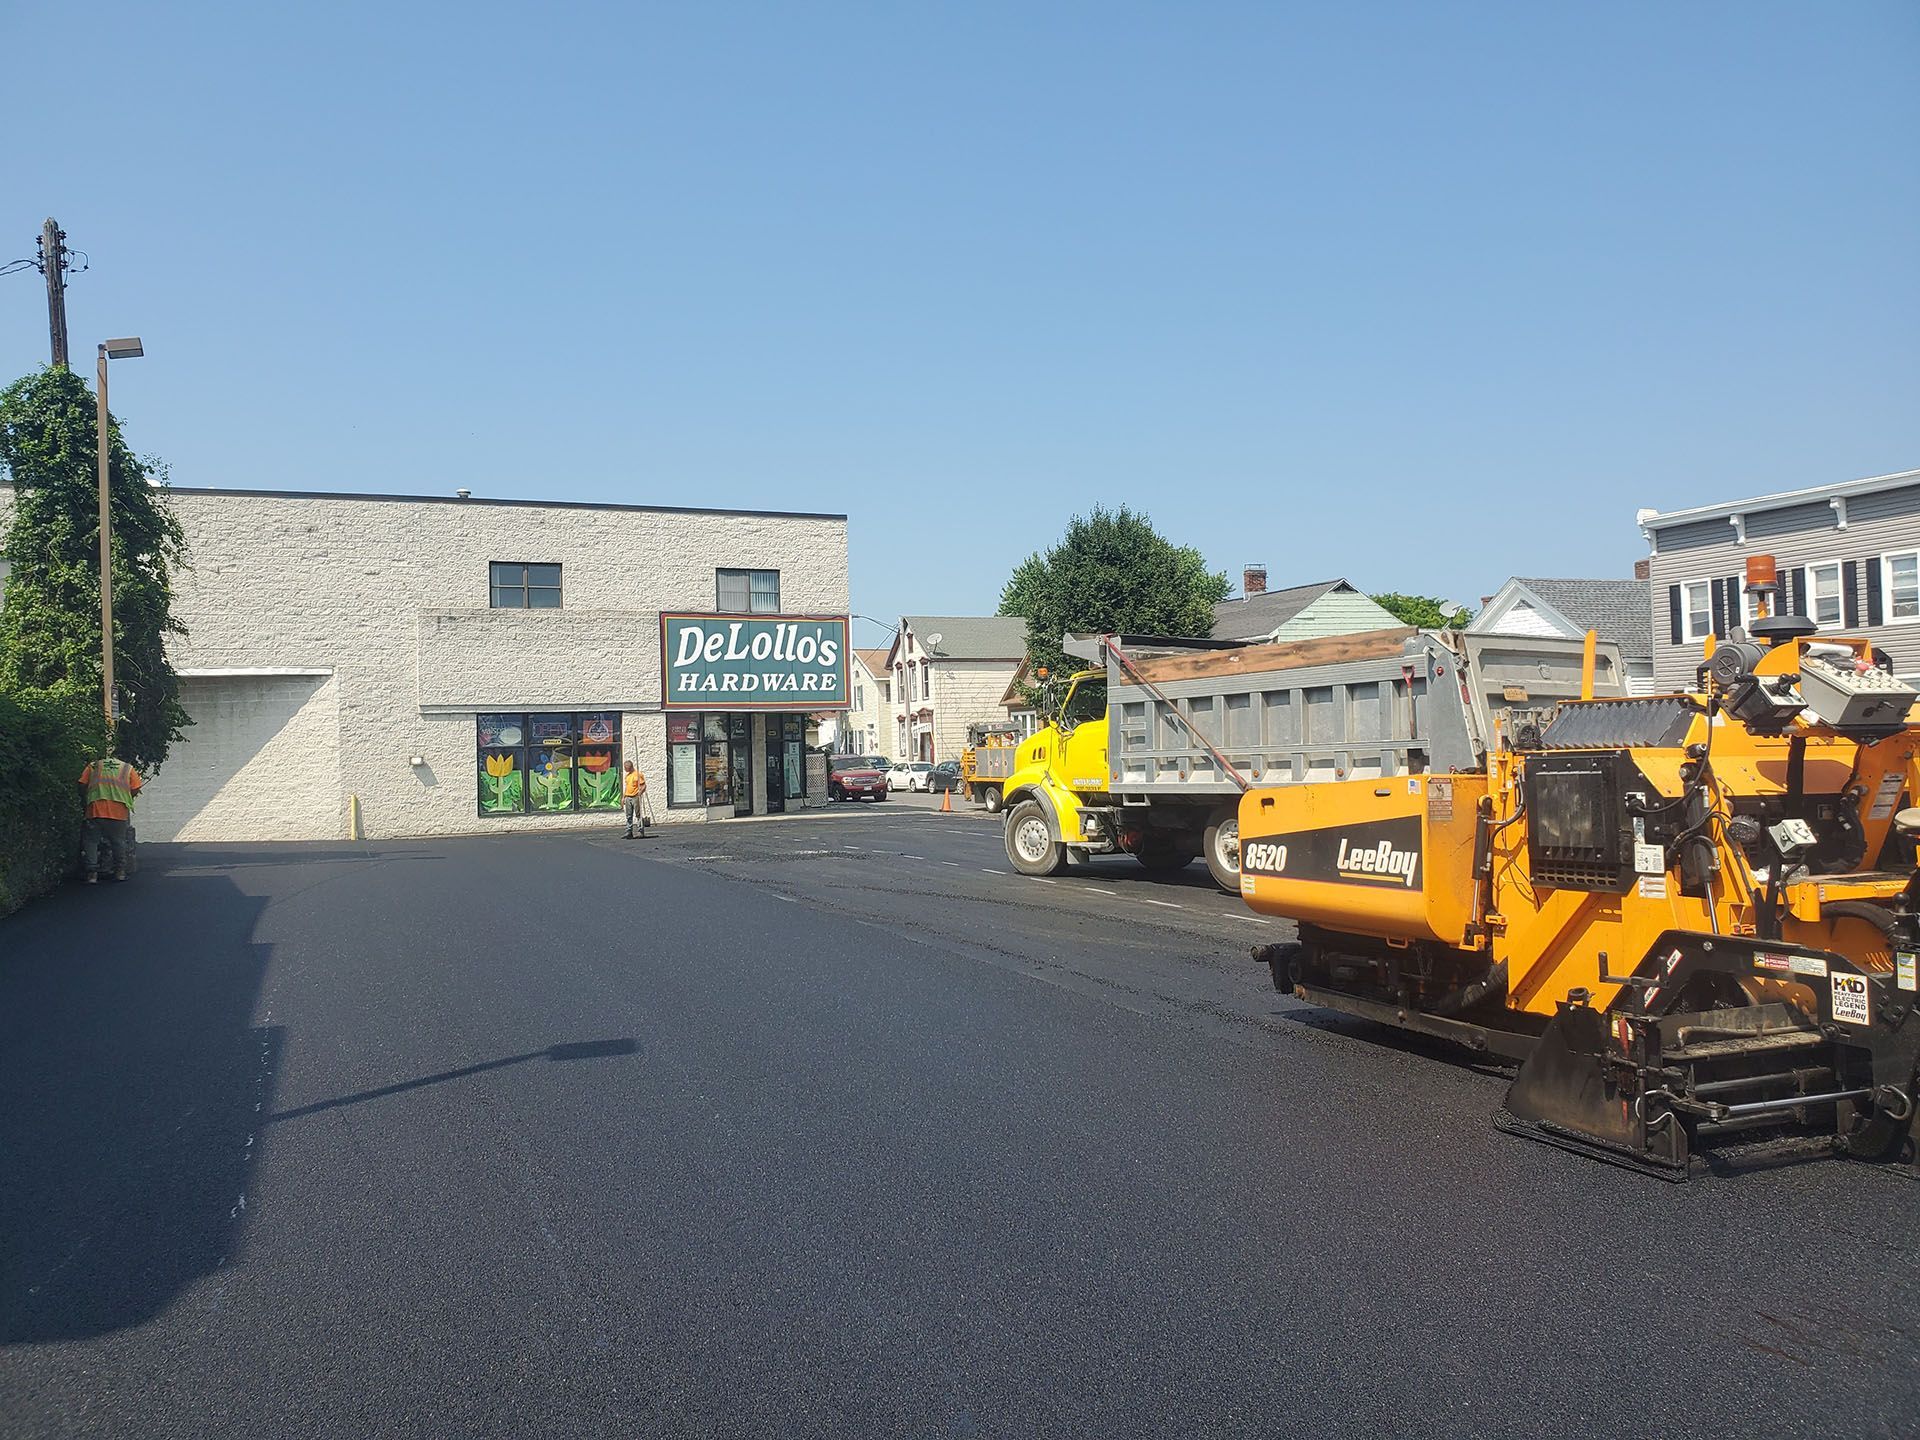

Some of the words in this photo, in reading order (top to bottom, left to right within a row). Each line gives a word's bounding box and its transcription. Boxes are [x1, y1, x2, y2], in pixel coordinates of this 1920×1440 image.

[673, 623, 838, 668] DeLollo's
[677, 673, 837, 692] HARDWARE
[1245, 843, 1288, 872] 8520
[1336, 838, 1418, 887] LeeBoy
[1834, 995, 1866, 1005] ELECTRIC
[1834, 1000, 1866, 1011] LEGEND
[1835, 1007, 1867, 1023] LeeBoy
